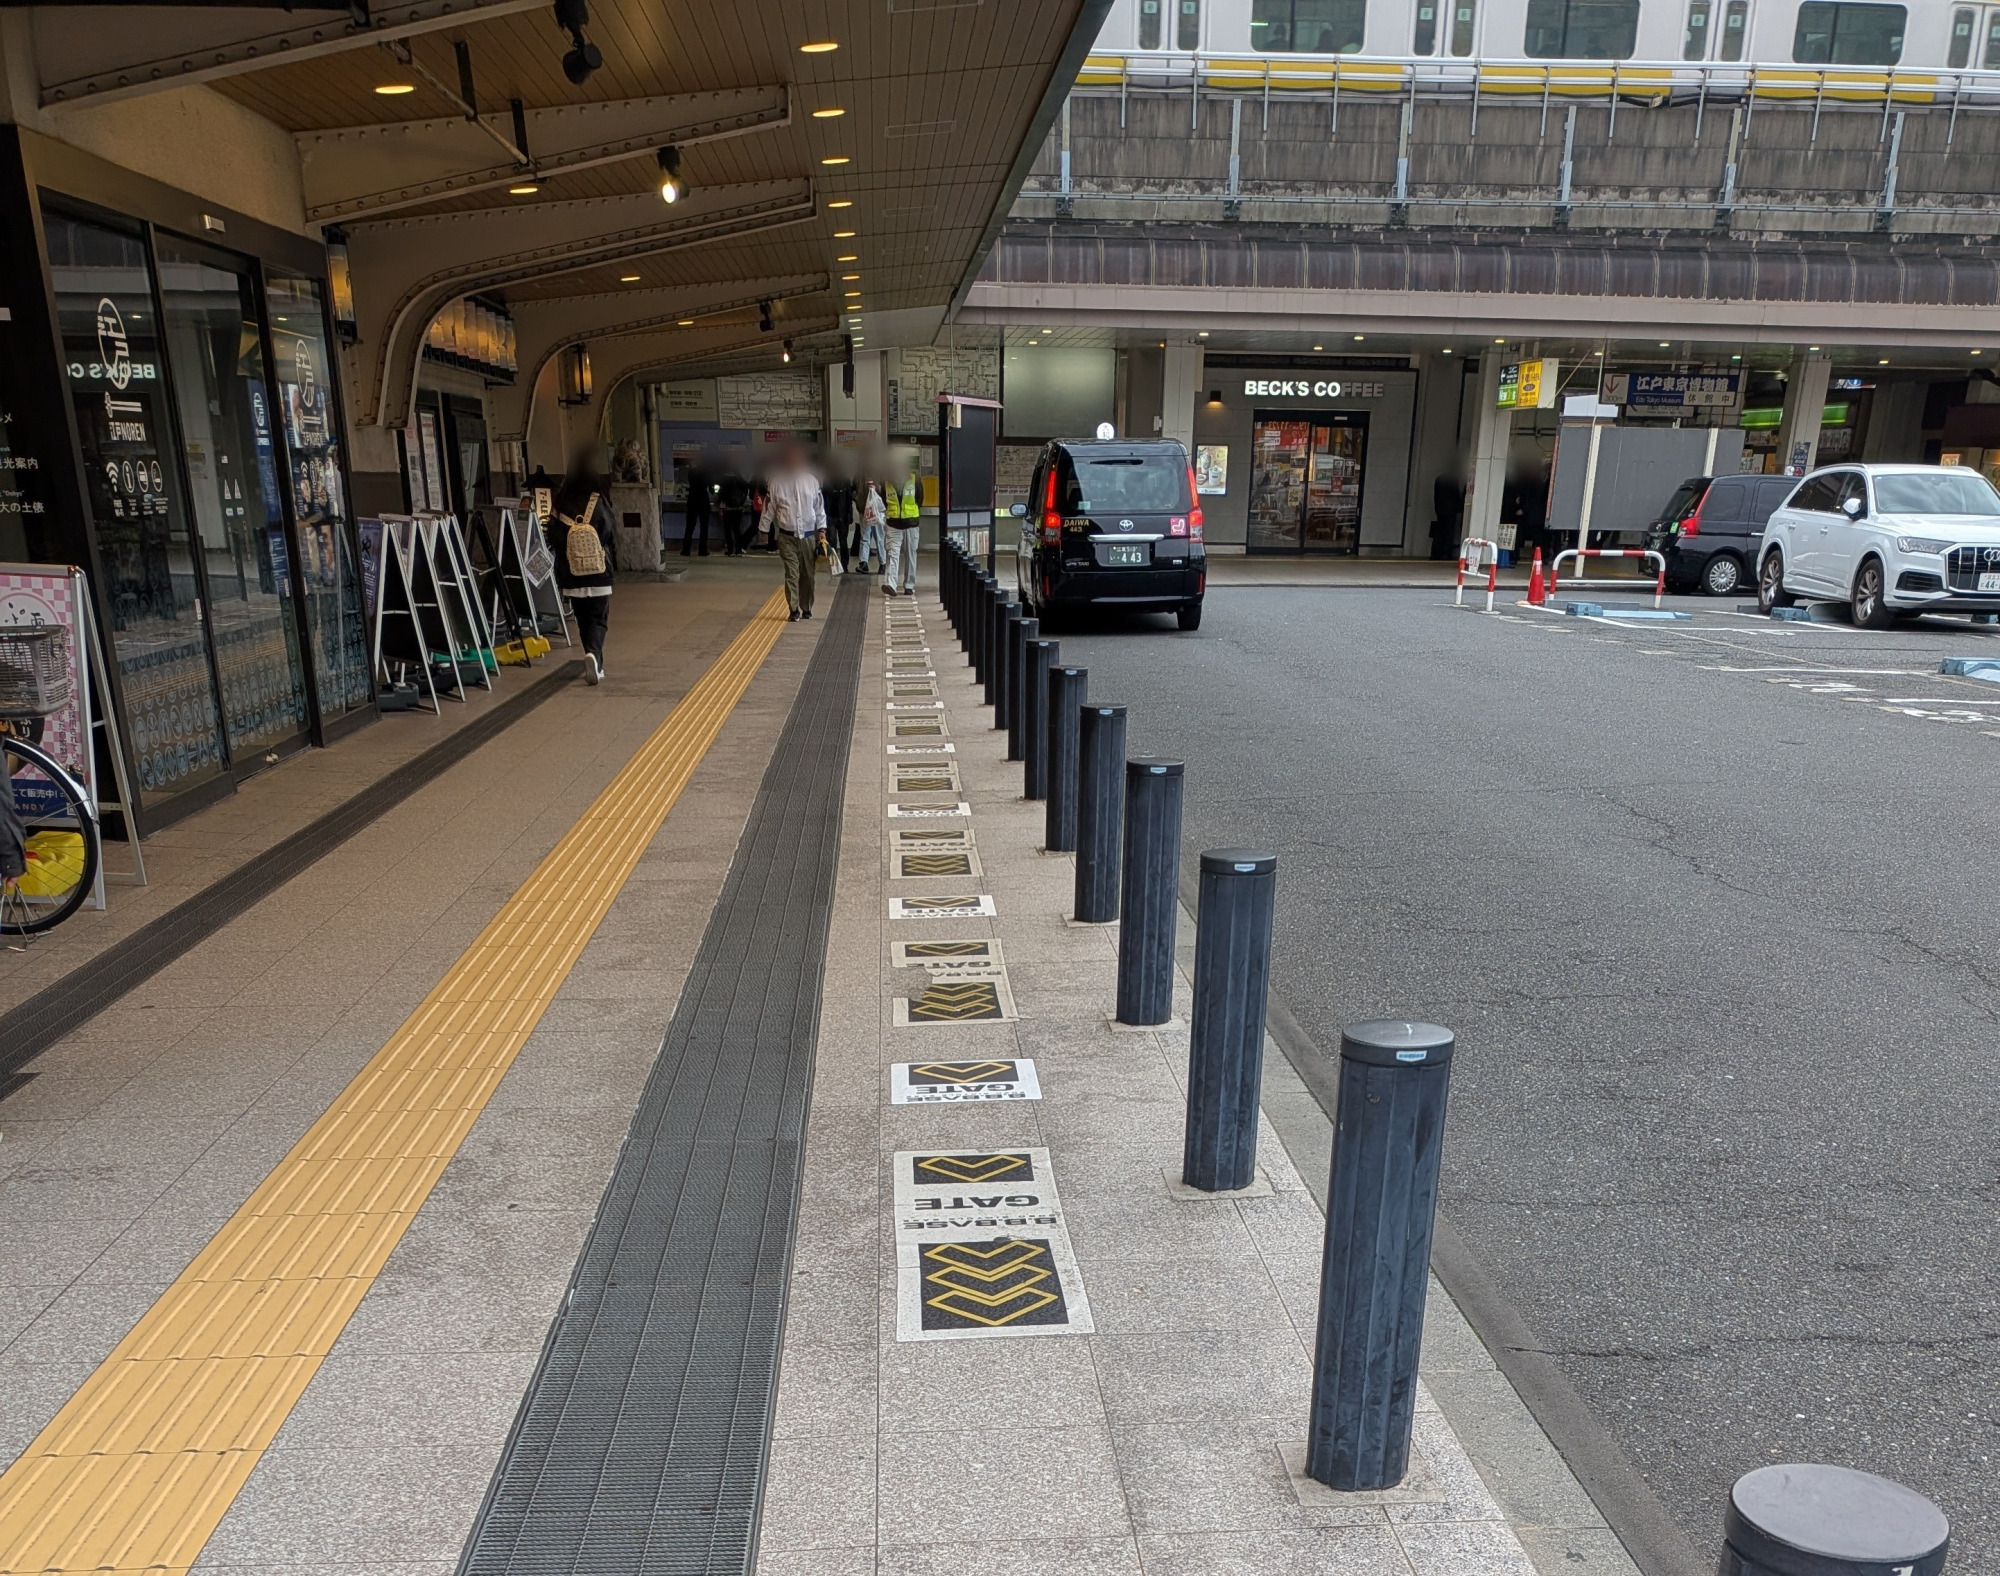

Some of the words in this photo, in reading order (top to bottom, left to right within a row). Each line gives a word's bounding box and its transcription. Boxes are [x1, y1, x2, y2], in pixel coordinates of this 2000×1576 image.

[1244, 380, 1310, 397] BECK'S
[1313, 381, 1384, 397] COFFEE
[1688, 393, 1730, 403] 休館中
[1064, 519, 1089, 527] DAIWA
[916, 1083, 1014, 1095] GATE
[914, 1195, 1040, 1210] GATE
